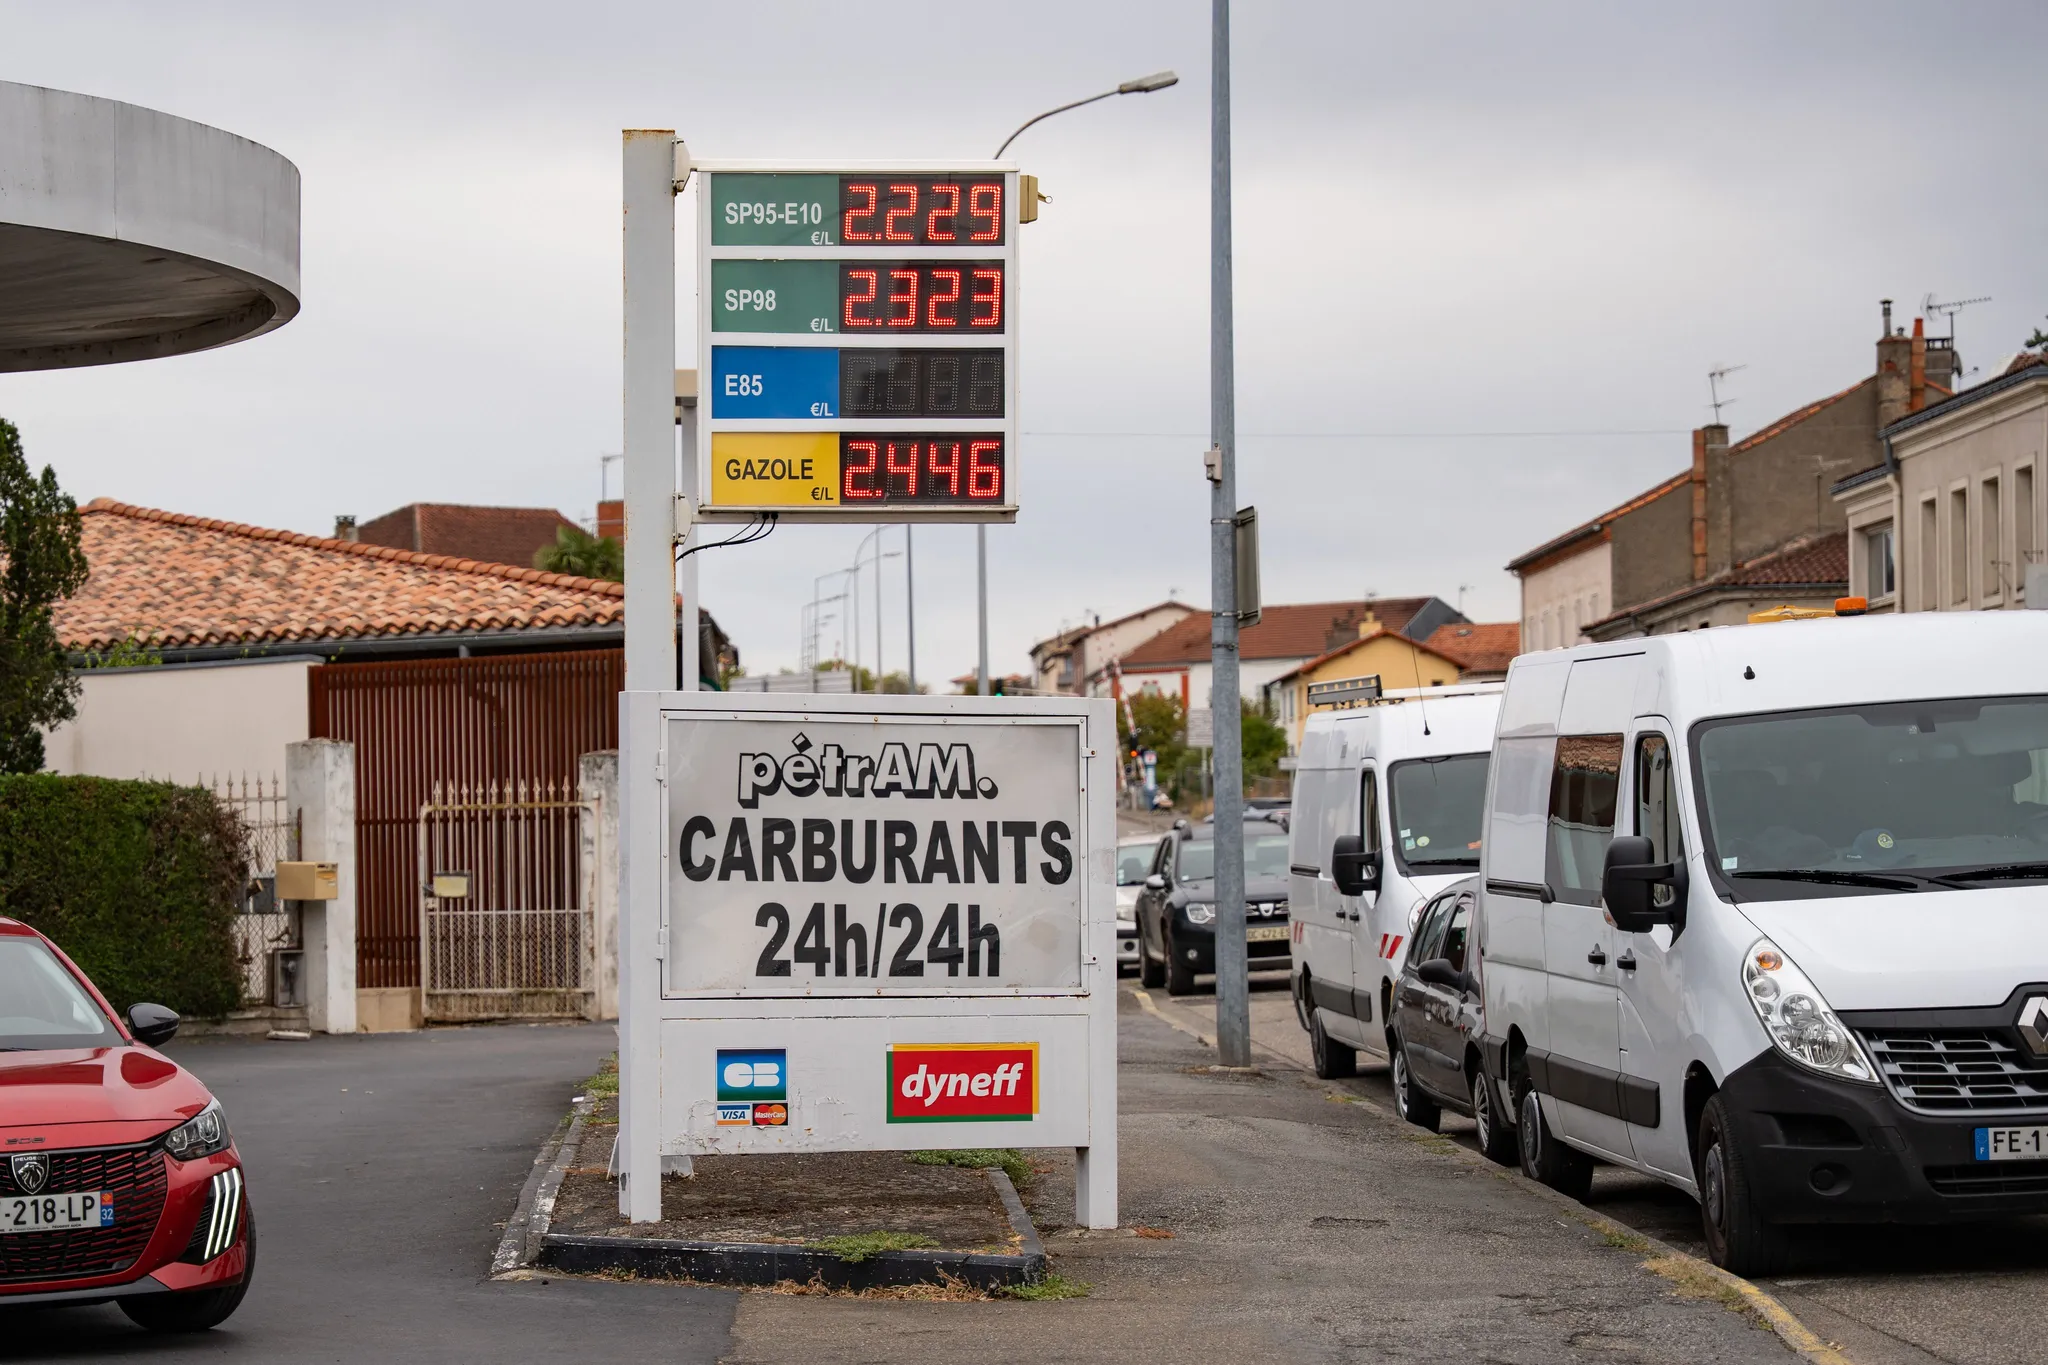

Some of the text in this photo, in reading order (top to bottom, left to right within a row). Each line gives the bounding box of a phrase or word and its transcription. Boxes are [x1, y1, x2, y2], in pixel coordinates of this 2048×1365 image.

[725, 185, 1001, 240] SP95-E10 2.229
[810, 232, 834, 246] €/L
[724, 271, 1001, 326] SP98 2.323
[810, 318, 834, 332] €/L
[725, 374, 763, 396] E85
[810, 403, 834, 416] €/L
[725, 442, 1001, 497] GAZOLE 2.446
[811, 487, 834, 501] €/L
[679, 815, 1073, 885] CARBURANTS
[755, 902, 1000, 978] 24h/24h
[901, 1062, 1024, 1107] dyneff
[722, 1110, 746, 1120] VISA
[754, 1111, 786, 1119] MasterCard
[1993, 1129, 2048, 1153] FE-1
[0, 1195, 95, 1226] -218-LP
[101, 1207, 114, 1220] 32
